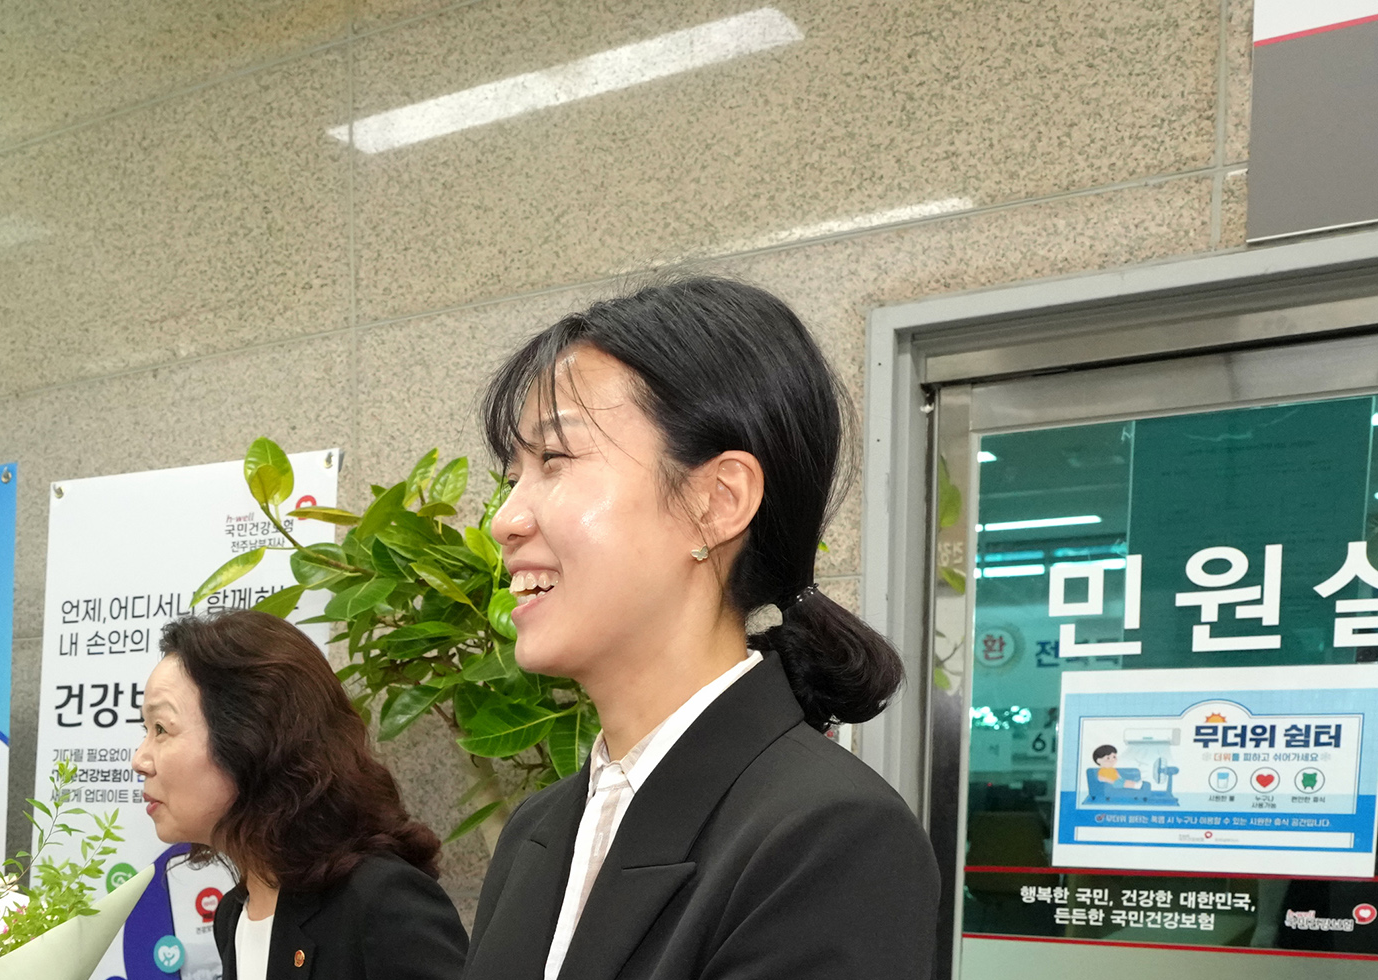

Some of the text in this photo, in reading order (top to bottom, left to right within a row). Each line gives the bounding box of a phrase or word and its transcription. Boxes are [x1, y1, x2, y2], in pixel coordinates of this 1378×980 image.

[225, 518, 294, 537] 국민건강보험
[62, 591, 197, 624] 언제,어디서나
[59, 628, 150, 656] 내 손안의
[982, 633, 1007, 661] 환
[1193, 723, 1343, 748] 무더위 쉼터
[52, 748, 131, 762] 기다릴 필요없이
[1213, 752, 1319, 762] 더위를 피하고 쉬어가세요
[85, 789, 129, 803] 업데이트
[1020, 885, 1256, 912] 행복한 국민, 건강한 대한민국,
[1054, 908, 1215, 930] 든든한 국민건강보험
